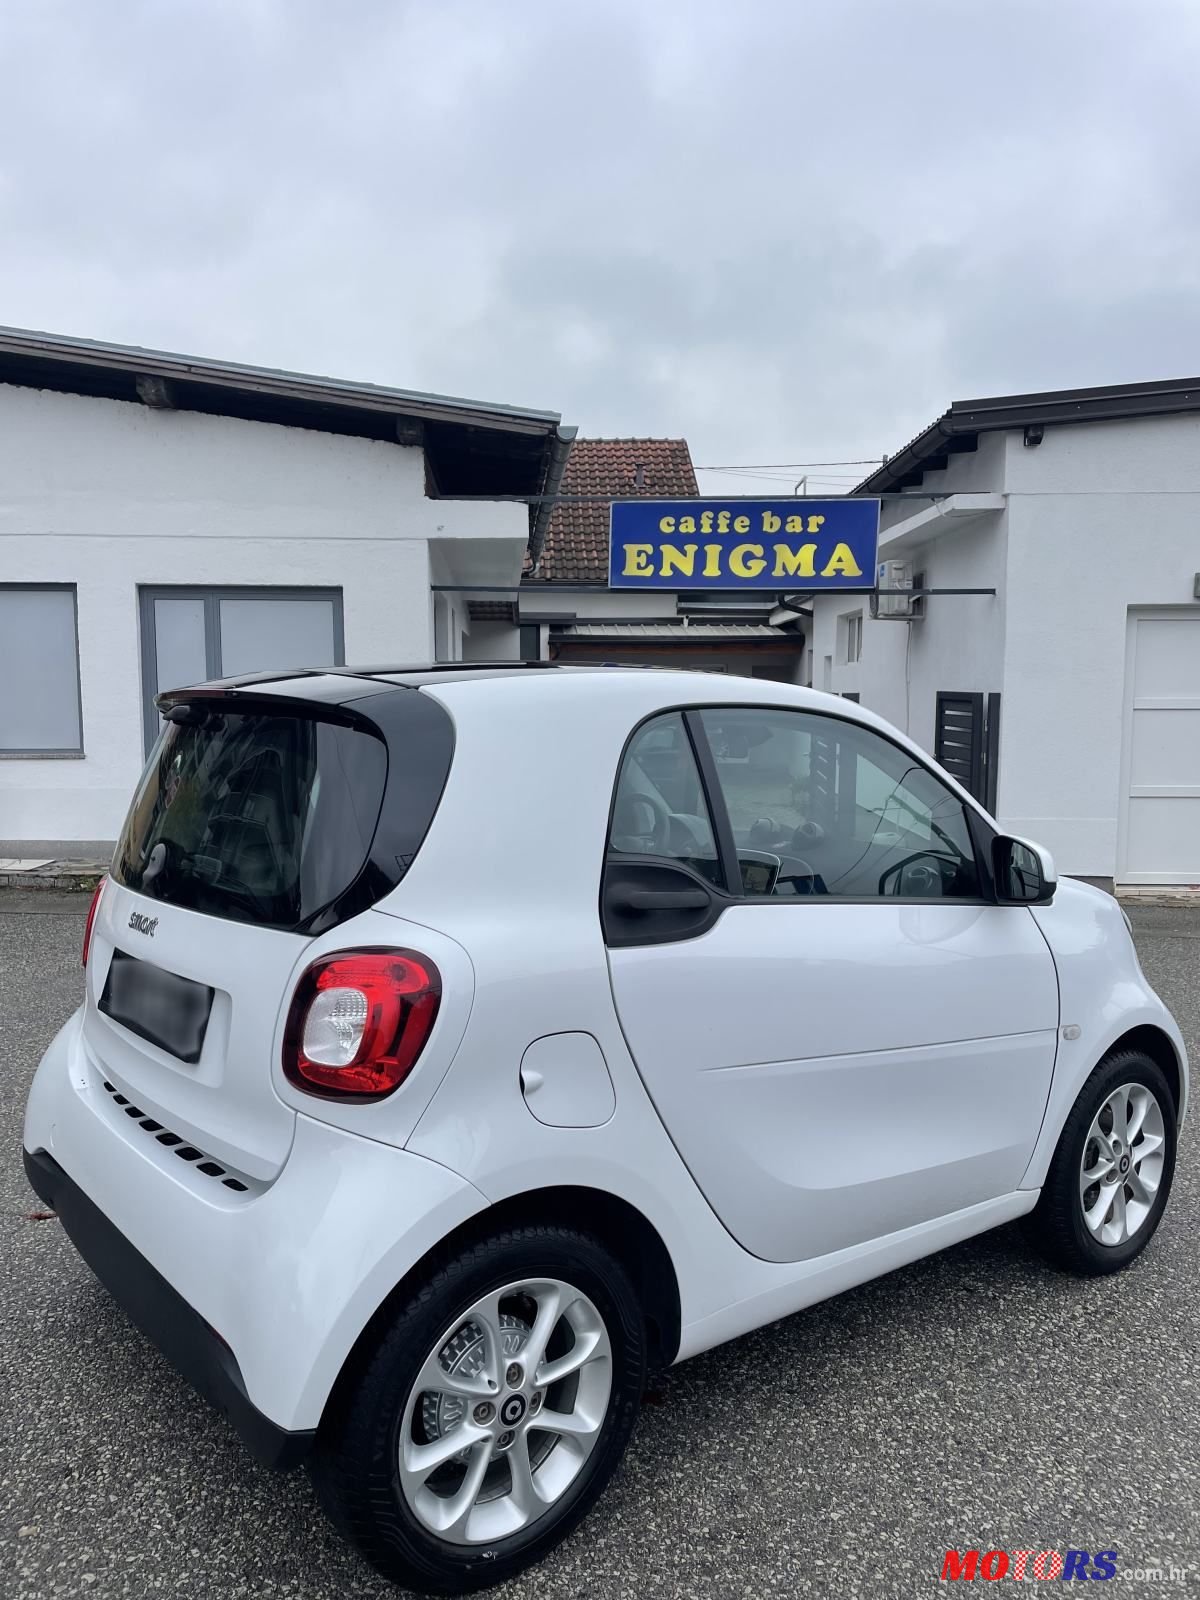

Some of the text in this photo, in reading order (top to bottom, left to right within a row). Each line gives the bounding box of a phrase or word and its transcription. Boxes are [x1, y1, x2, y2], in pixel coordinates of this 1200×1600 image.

[659, 511, 825, 533] caffe bar
[622, 543, 863, 578] ENIGMA
[128, 912, 159, 937] smart
